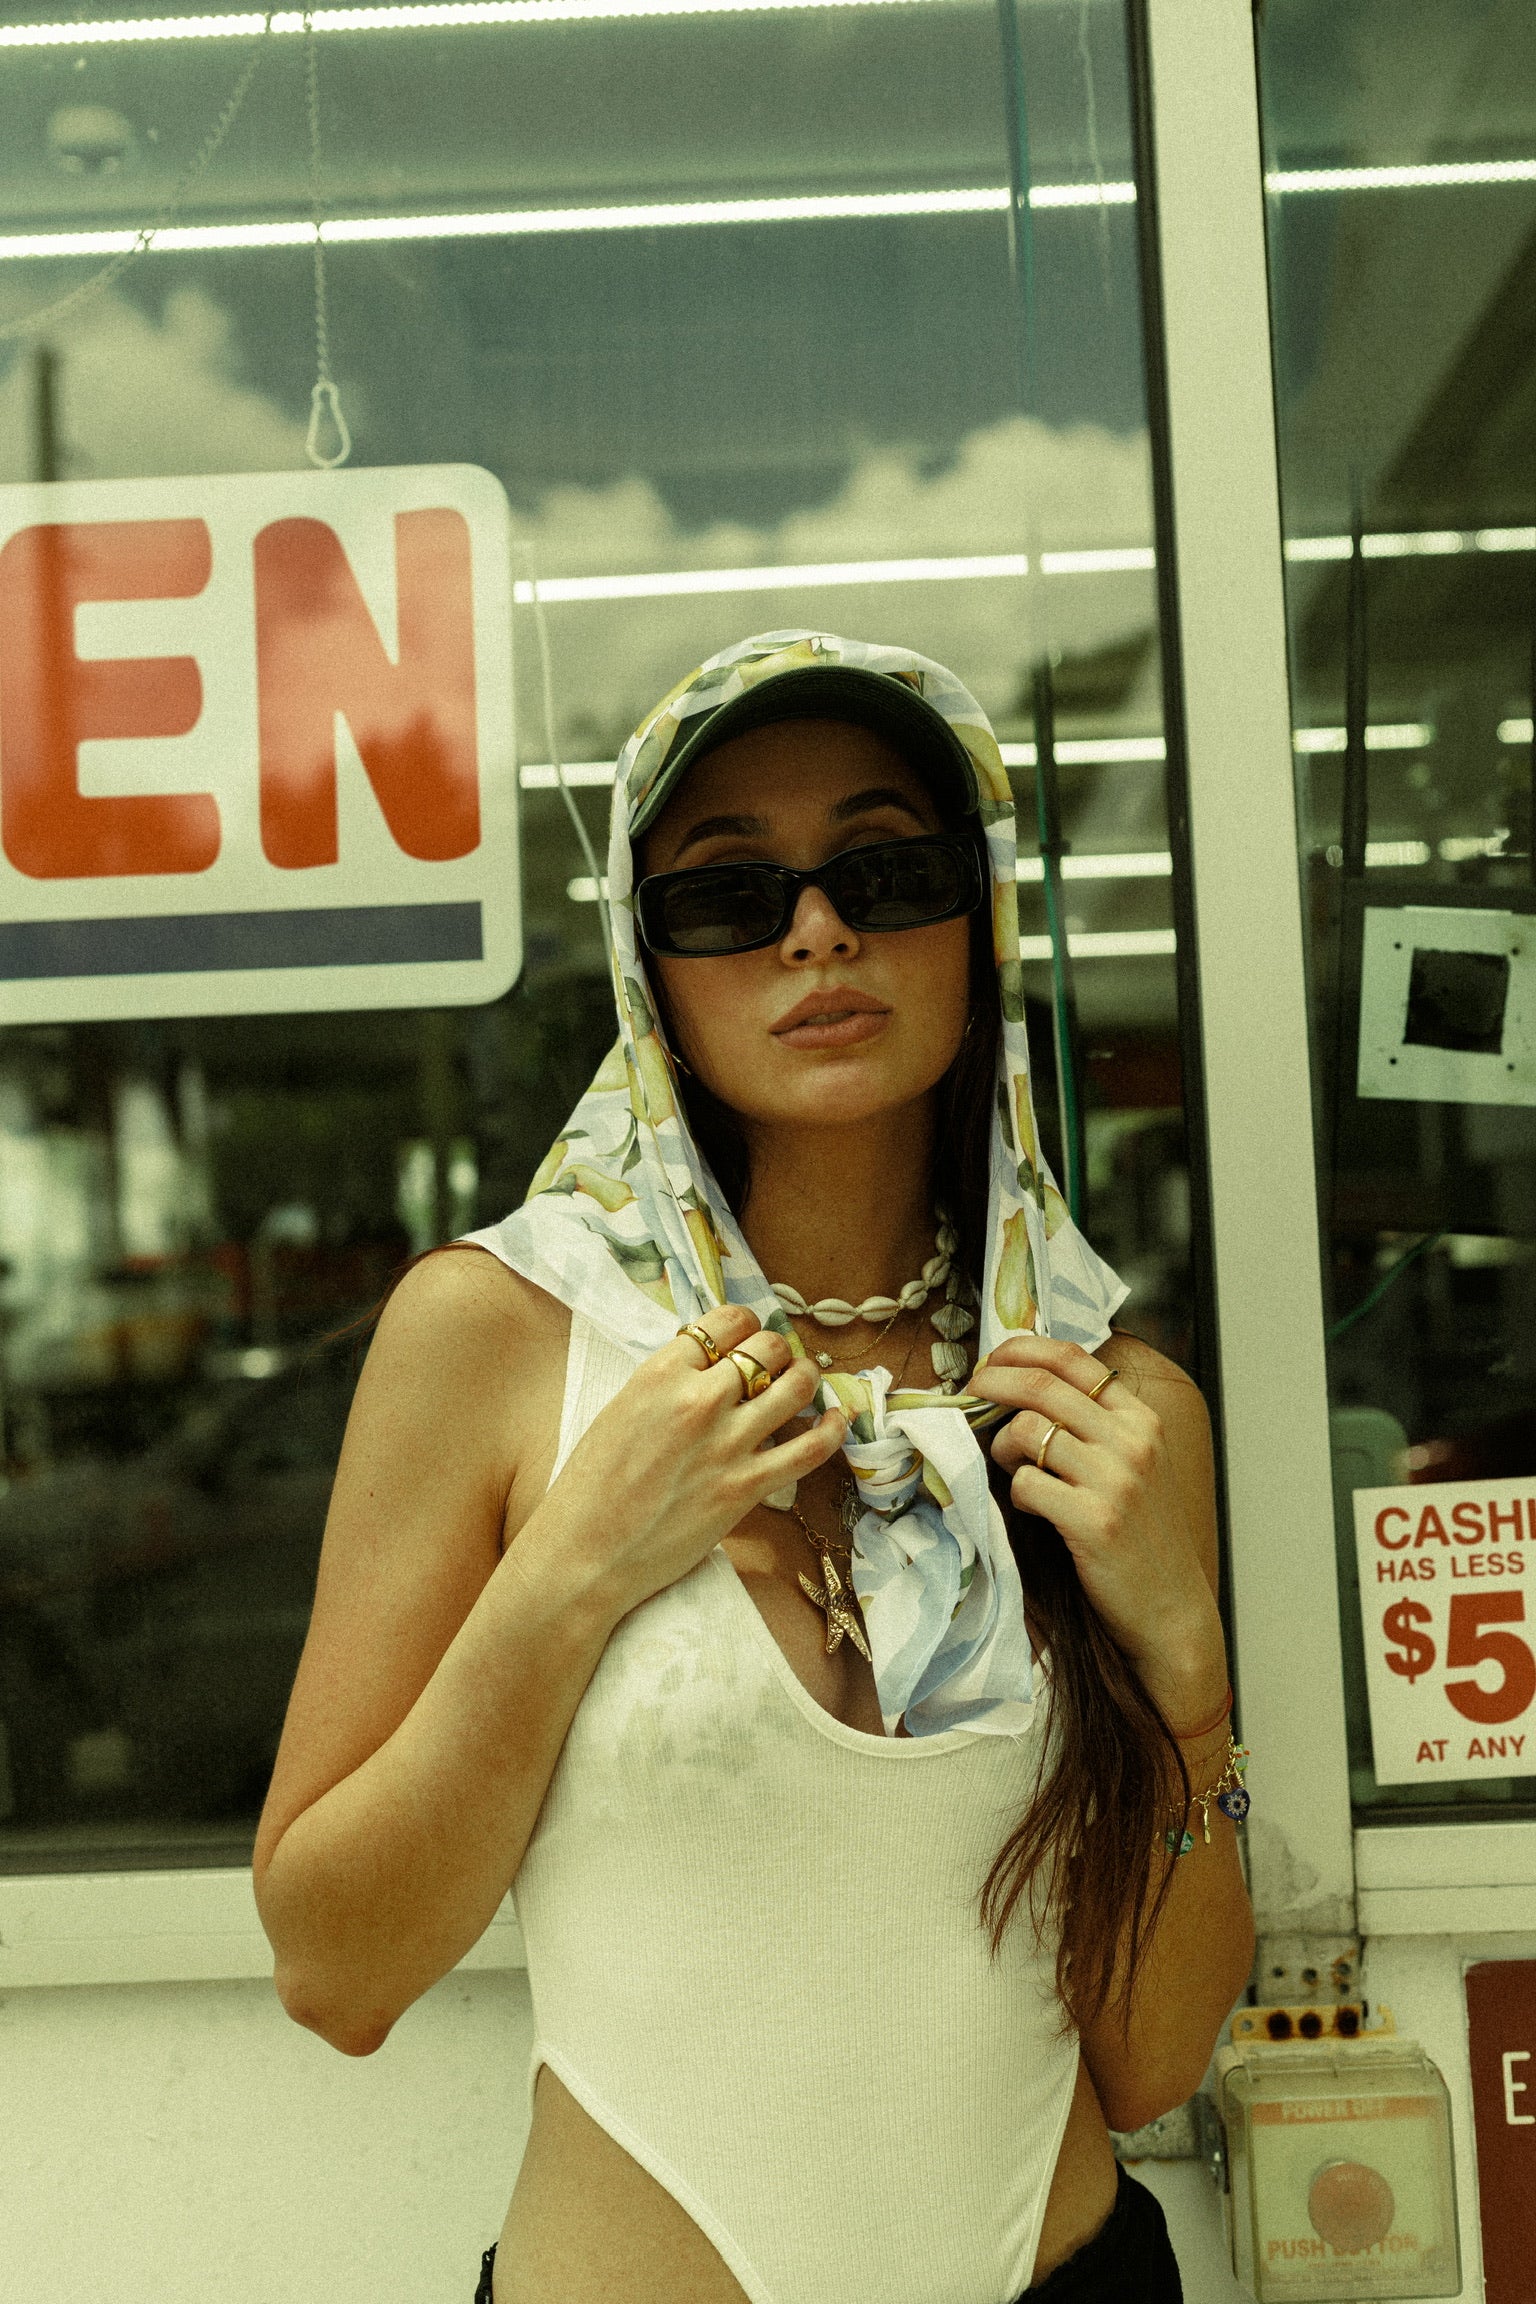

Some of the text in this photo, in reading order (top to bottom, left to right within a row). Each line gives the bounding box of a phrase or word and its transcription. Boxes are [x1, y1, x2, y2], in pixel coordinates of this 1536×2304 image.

[0, 506, 482, 881] EN
[1376, 1551, 1526, 1583] HAS LESS
[1382, 1590, 1536, 1726] $5
[1416, 1735, 1526, 1763] AT ANY
[1502, 2051, 1536, 2126] E
[1267, 2239, 1326, 2261] PUSH
